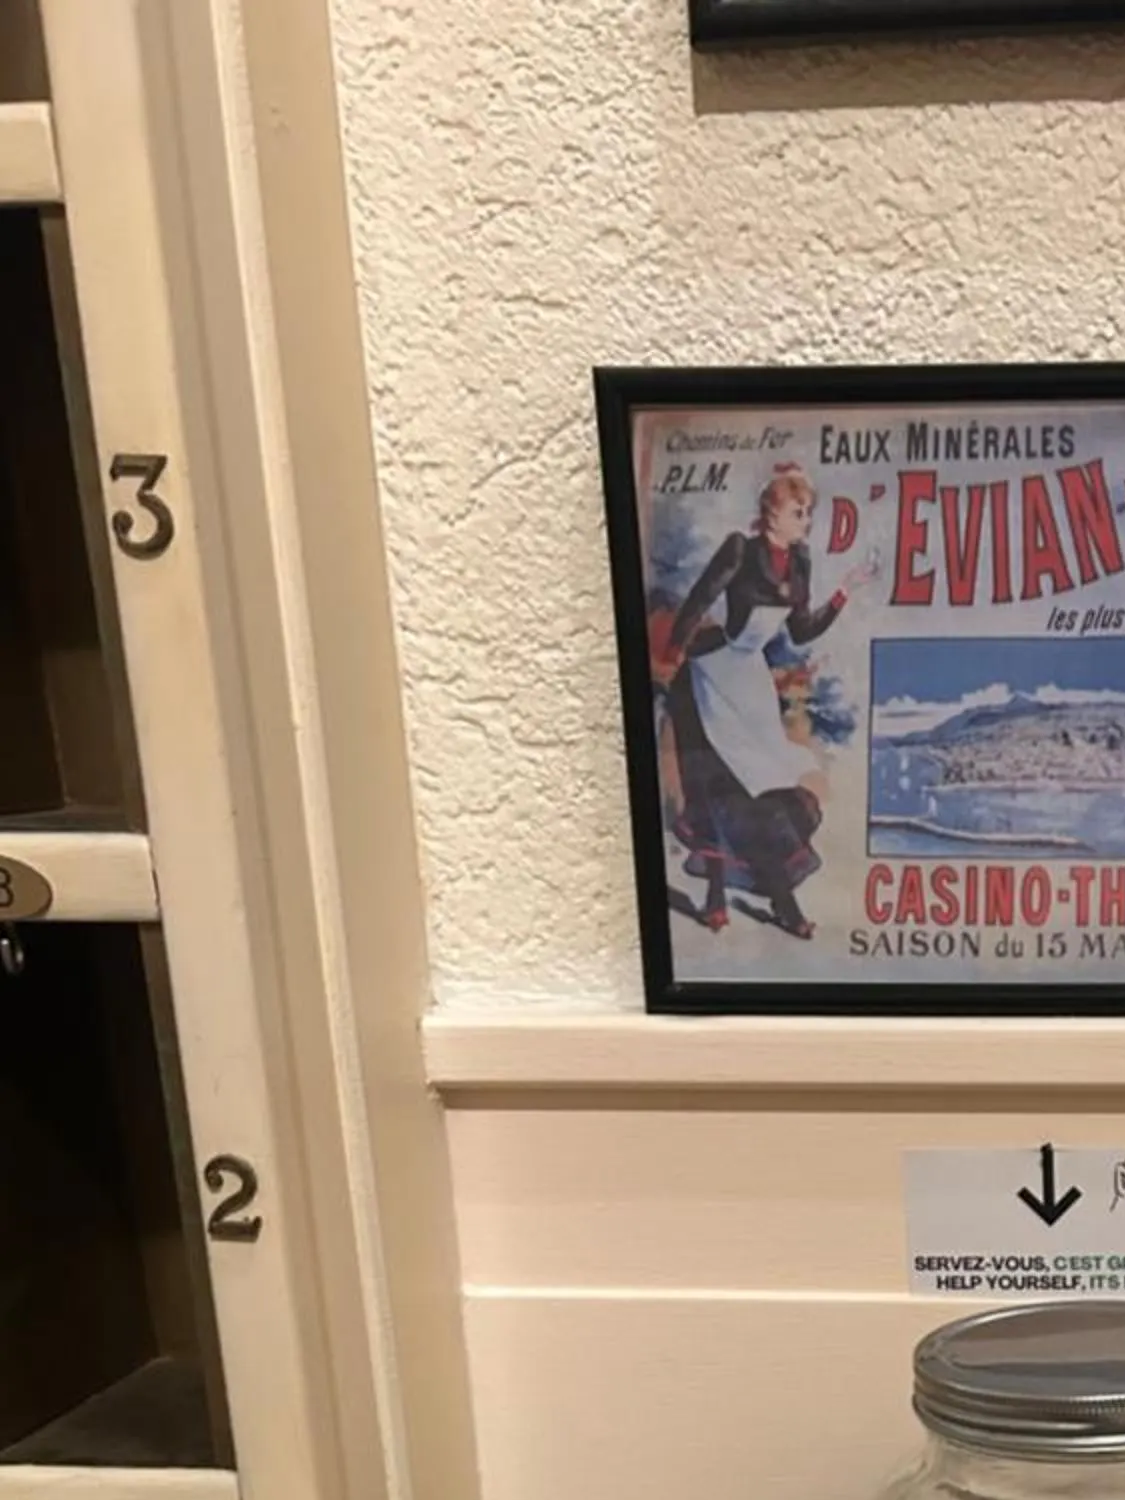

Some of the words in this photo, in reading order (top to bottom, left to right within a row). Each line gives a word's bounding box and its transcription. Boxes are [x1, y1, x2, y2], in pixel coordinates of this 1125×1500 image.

[820, 424, 891, 464] EAUX
[906, 420, 1075, 462] MINÉRALES
[109, 455, 174, 560] 3
[1046, 604, 1075, 631] les
[1080, 604, 1125, 634] plus
[850, 930, 981, 958] SAISON
[995, 932, 1024, 958] du
[1036, 932, 1067, 958] 15
[204, 1154, 263, 1243] 2
[914, 1255, 1050, 1272] SERVEZ-VOUS,
[936, 1275, 982, 1290] HELP
